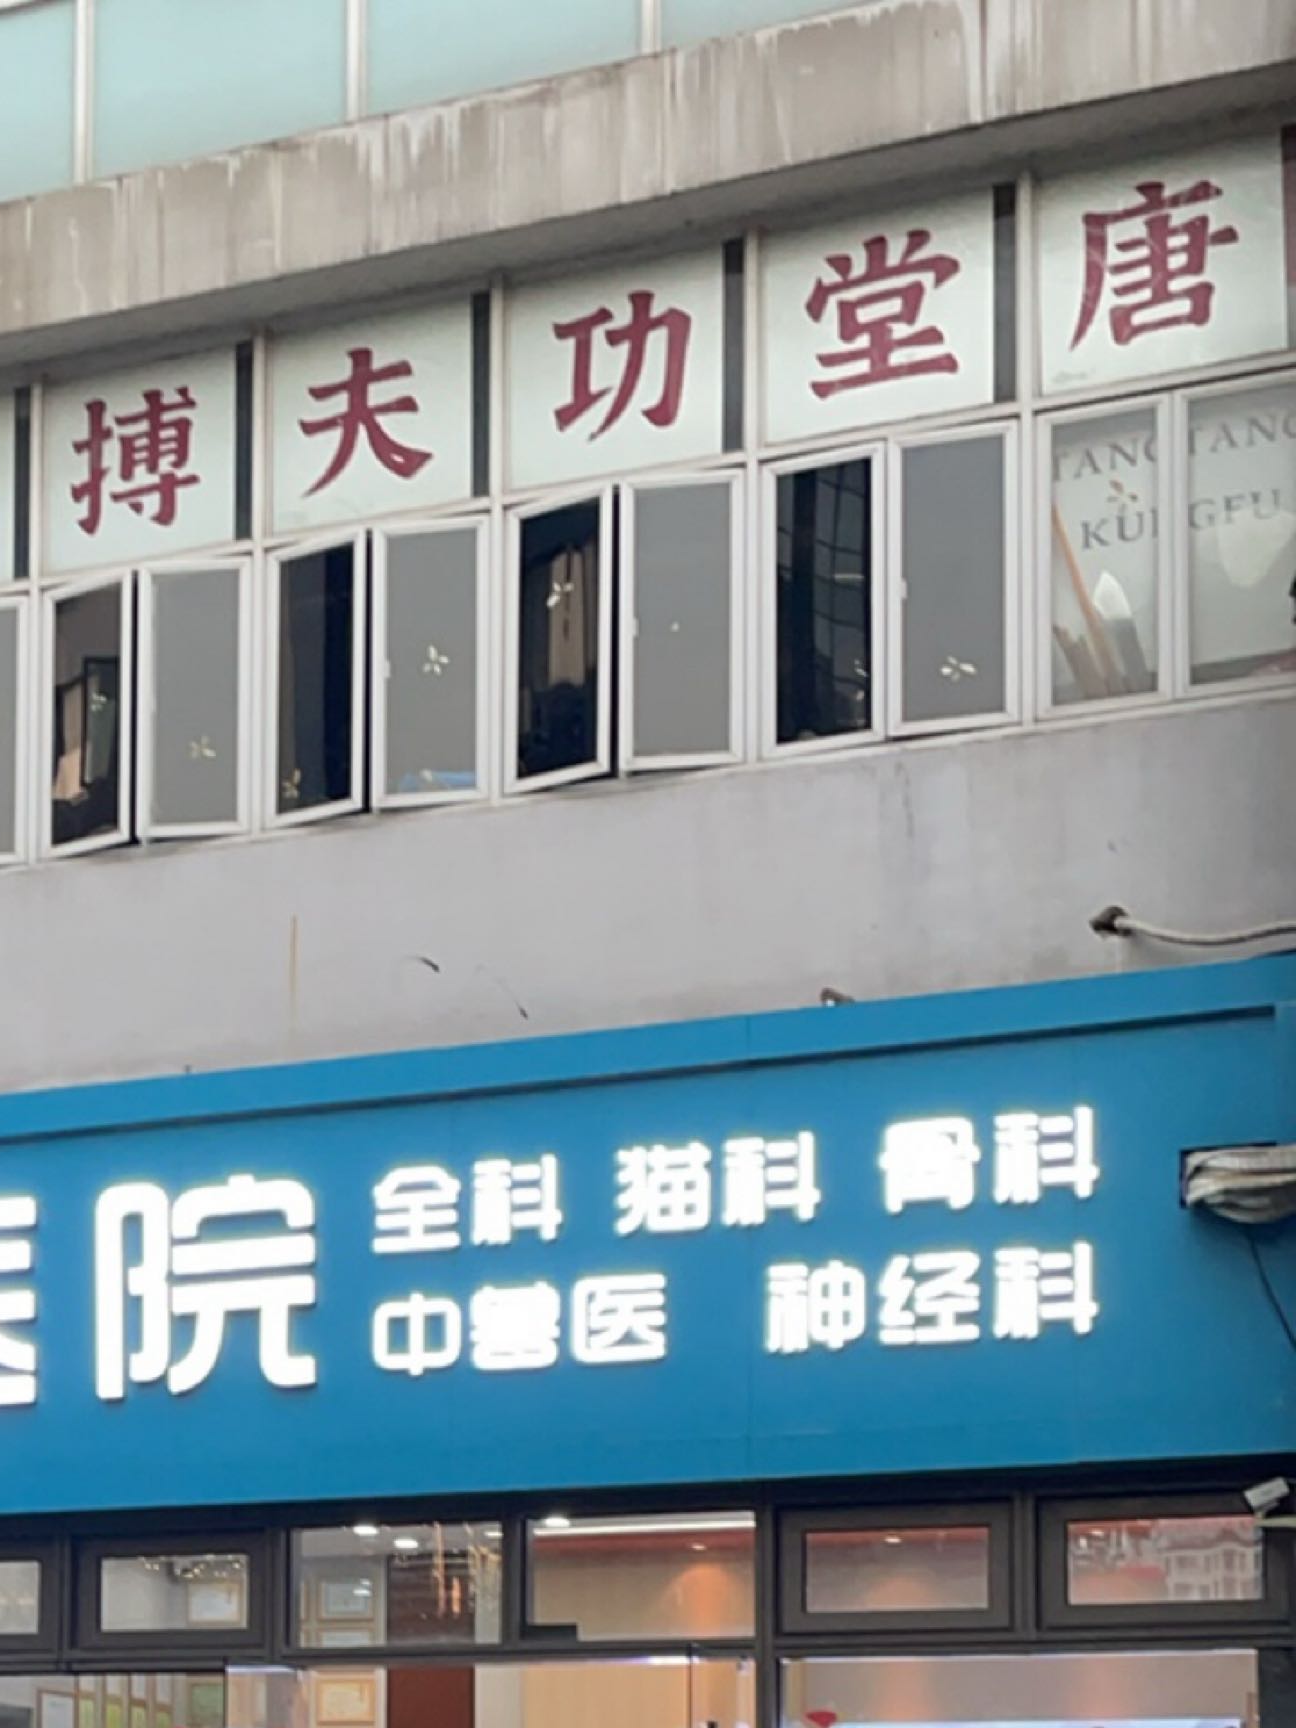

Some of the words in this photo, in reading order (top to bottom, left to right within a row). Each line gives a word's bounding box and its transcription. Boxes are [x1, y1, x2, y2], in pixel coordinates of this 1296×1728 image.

[1080, 488, 1282, 551] KUGFU
[373, 1154, 563, 1253] 全科
[616, 1131, 821, 1234] 猫科
[878, 1105, 1100, 1213] 骨科
[766, 1241, 1099, 1353] 神经科
